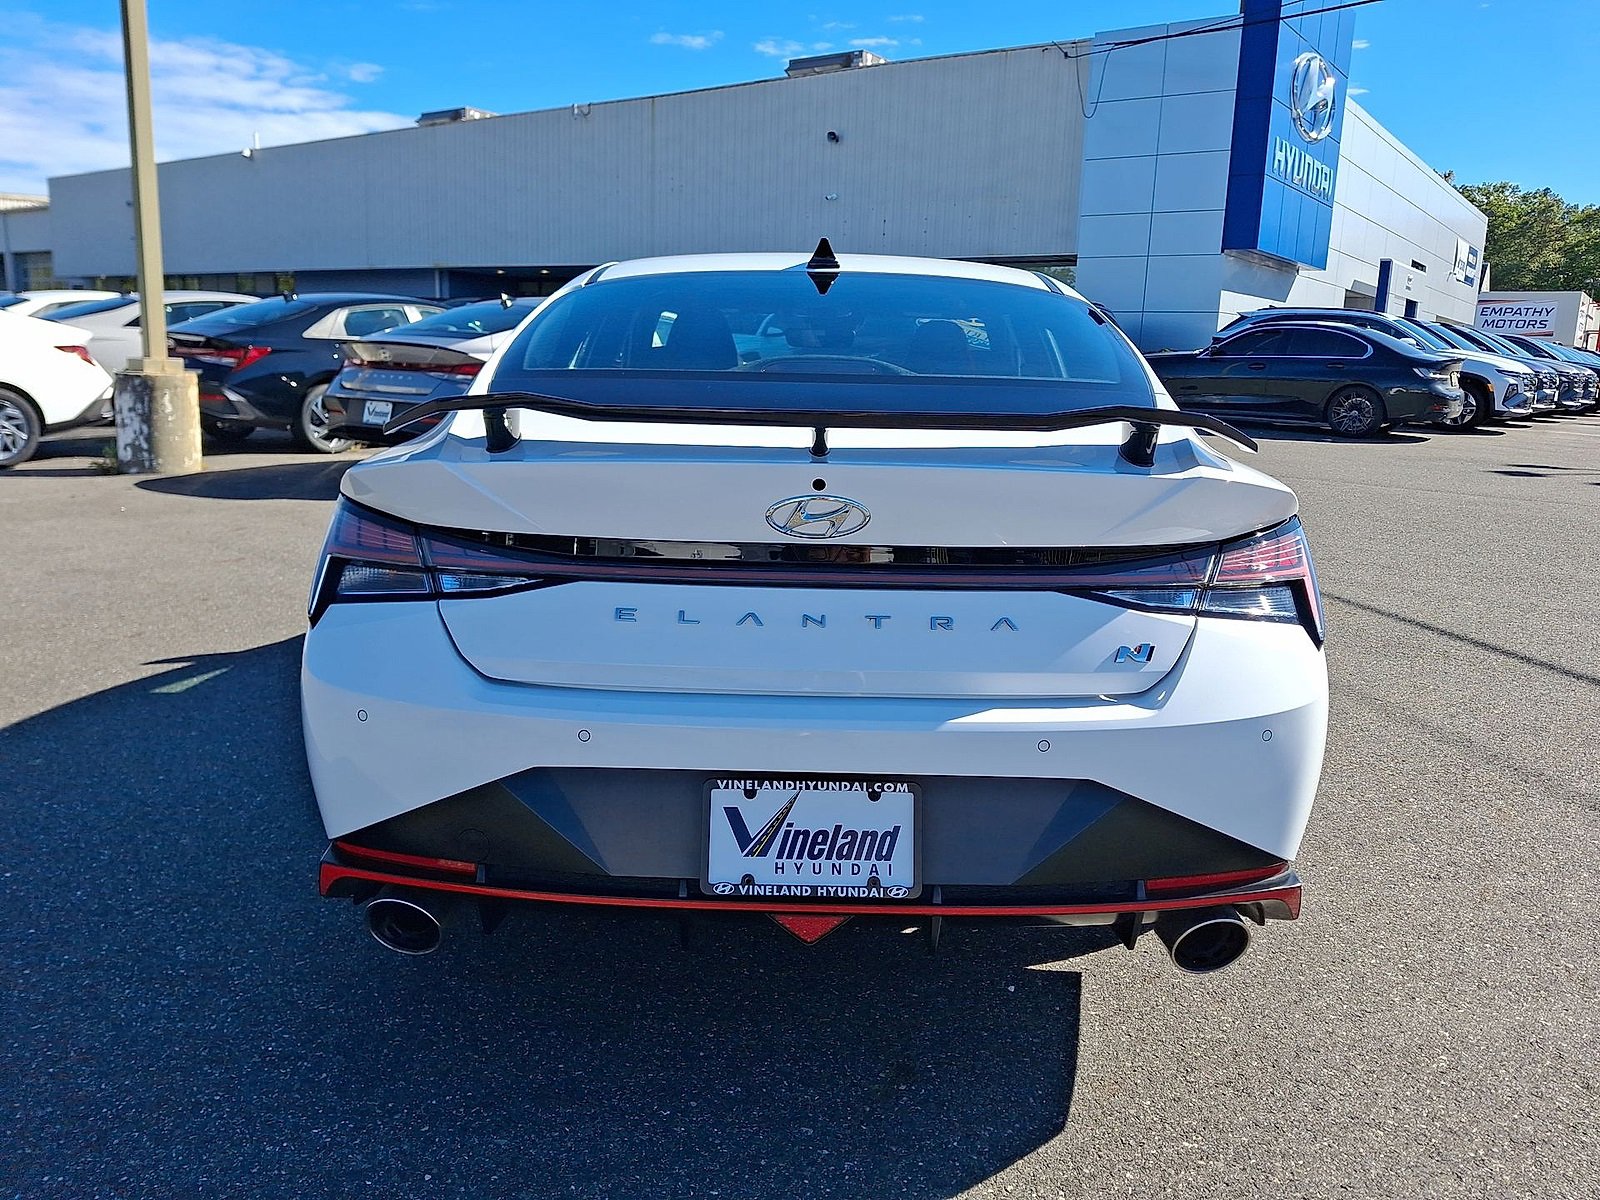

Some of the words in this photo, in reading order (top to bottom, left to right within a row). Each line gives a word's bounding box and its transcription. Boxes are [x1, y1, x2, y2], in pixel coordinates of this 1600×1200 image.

[1272, 136, 1334, 202] HYUNDAI
[1480, 306, 1555, 317] EMPATHY
[1481, 319, 1548, 329] MOTORS
[614, 606, 1019, 631] ELANTRA
[716, 779, 909, 793] VINELANDHYUNDAI.COM
[722, 790, 902, 862] Vineland
[774, 862, 892, 876] HYUNDAI
[739, 885, 811, 896] VINELAND
[818, 886, 884, 898] HYUNDAI
